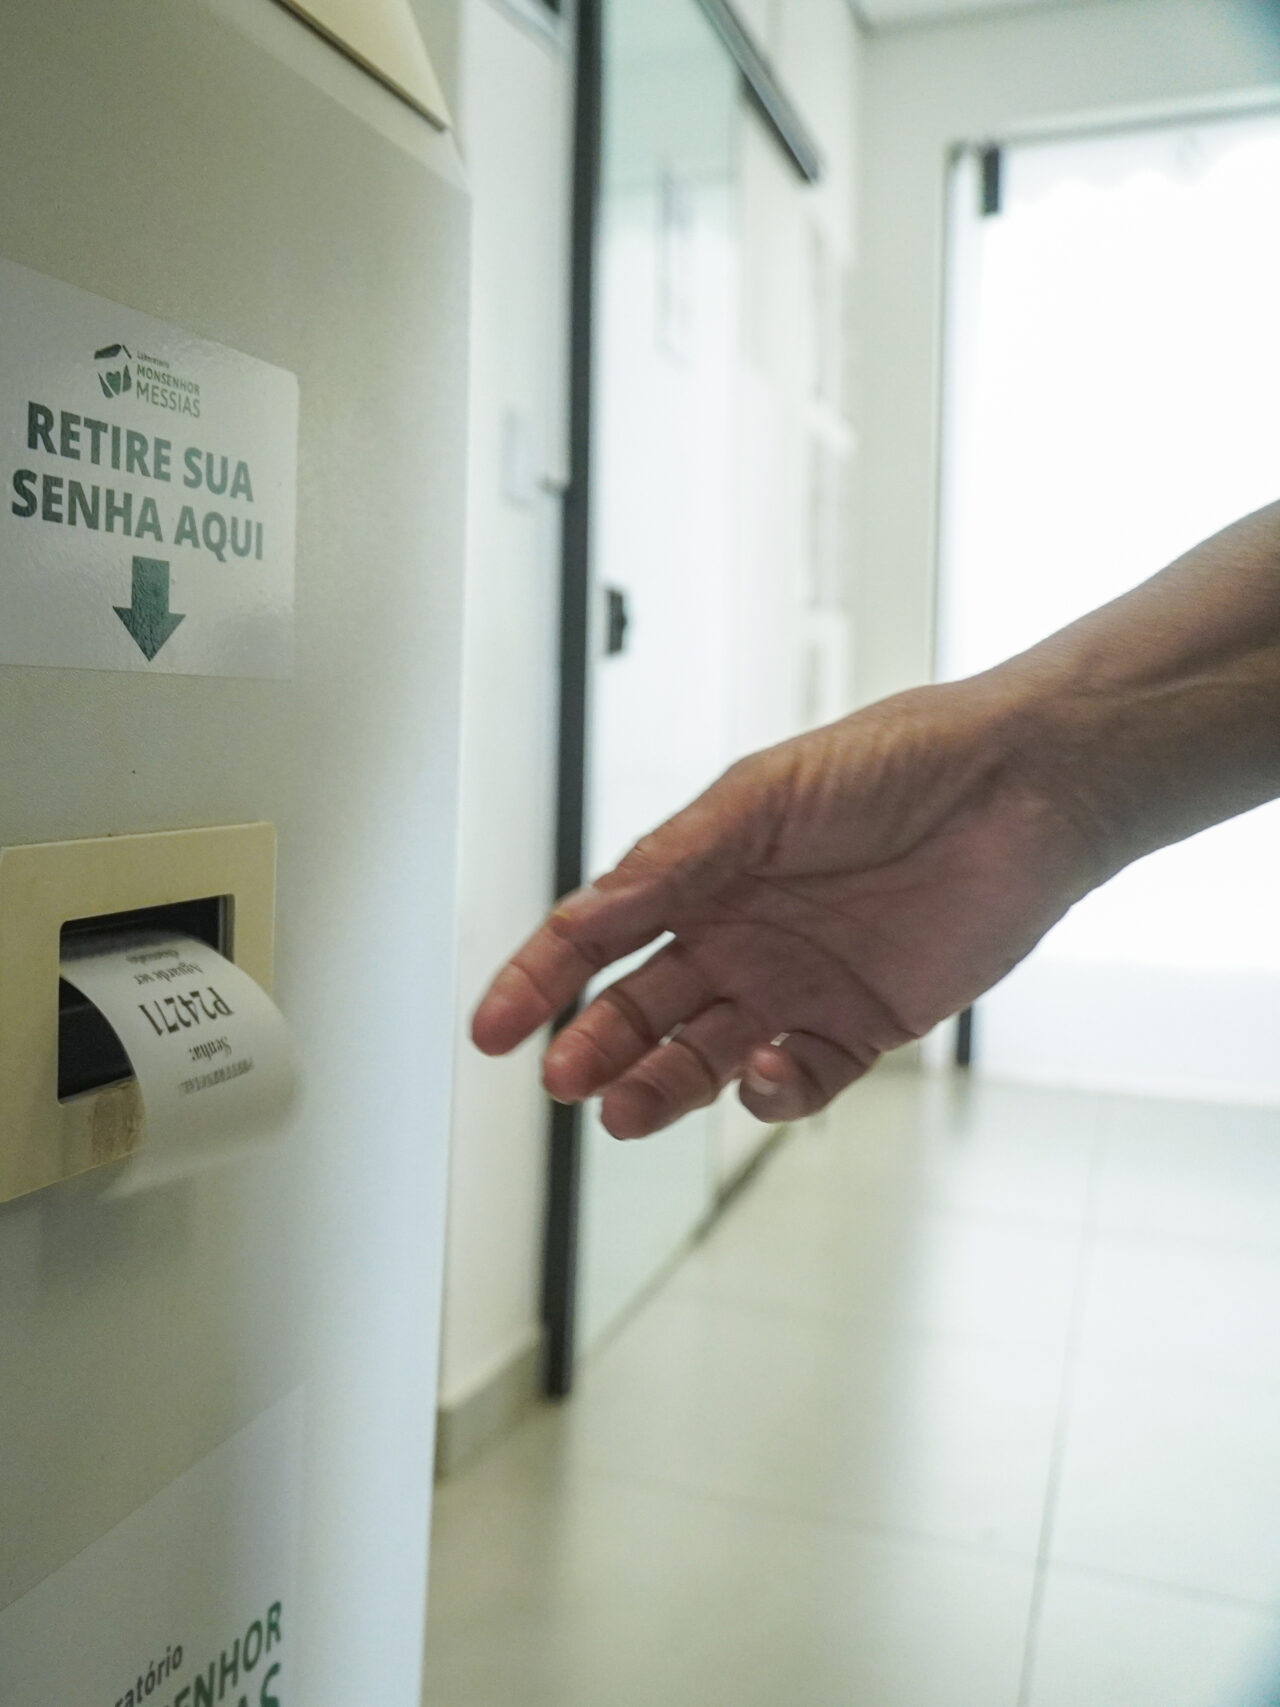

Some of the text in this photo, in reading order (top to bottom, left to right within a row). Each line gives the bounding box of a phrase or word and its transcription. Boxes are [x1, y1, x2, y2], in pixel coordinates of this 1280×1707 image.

[136, 364, 200, 396] MONSENHOR
[136, 379, 201, 418] MESSIAS
[27, 401, 254, 503] RETIRE SUA
[10, 468, 264, 563] SENHA AQUI
[138, 986, 235, 1036] P24271
[188, 1036, 233, 1062] Senha:
